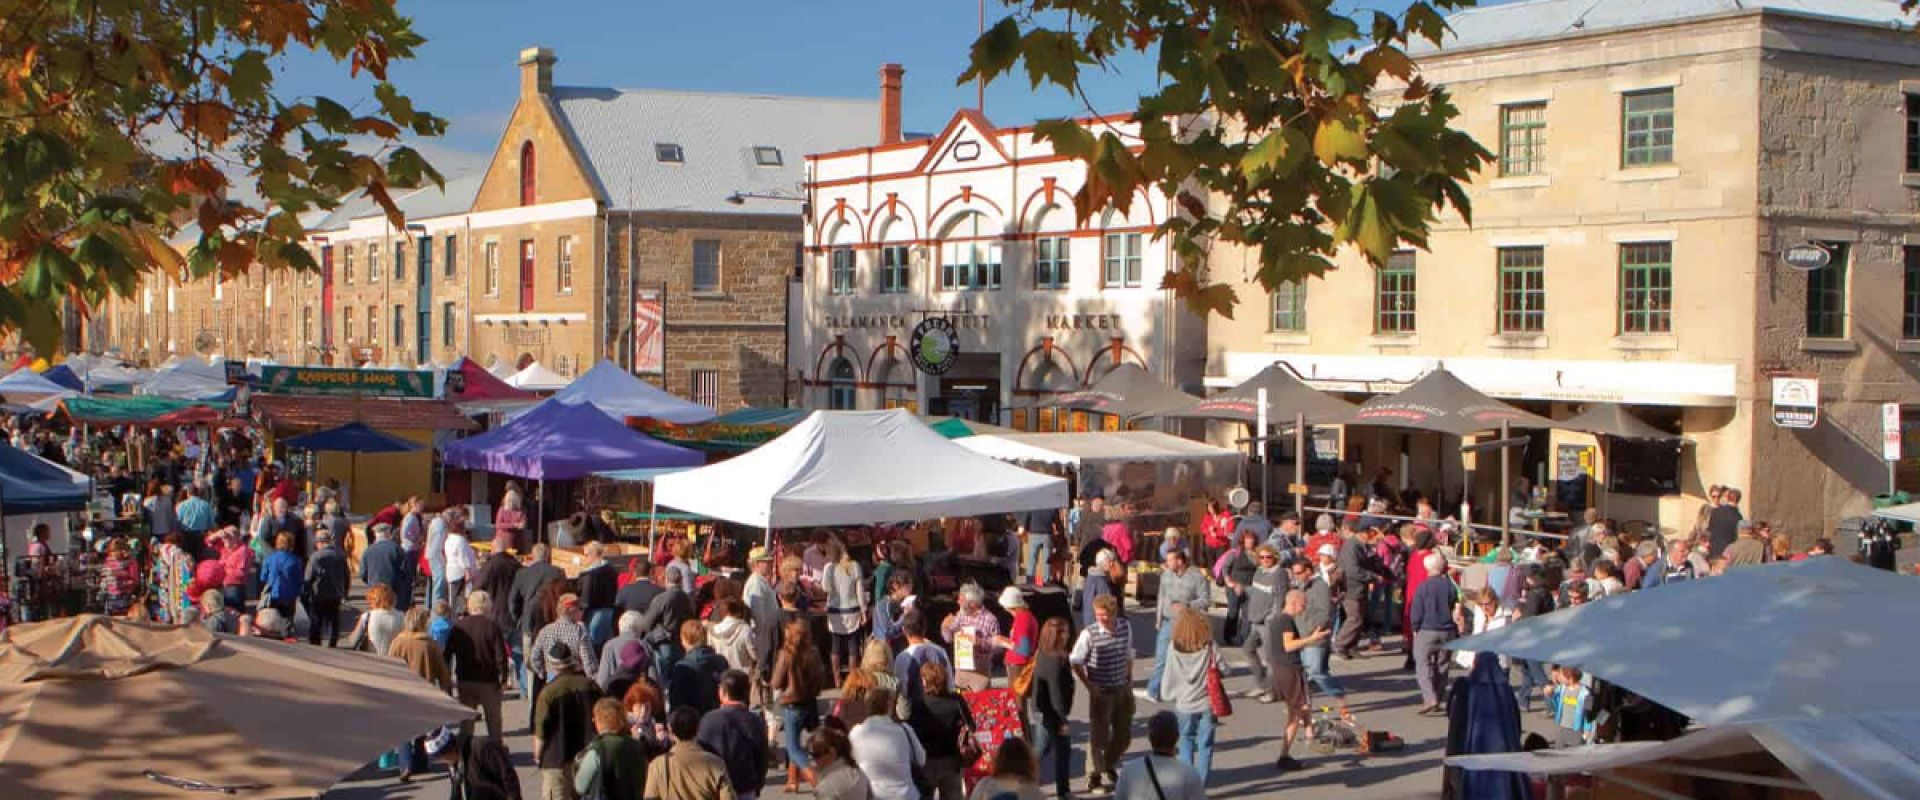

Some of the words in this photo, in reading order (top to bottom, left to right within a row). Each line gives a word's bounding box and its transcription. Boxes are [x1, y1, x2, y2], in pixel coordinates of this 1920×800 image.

[825, 315, 905, 329] SALAMANCA
[944, 314, 990, 329] RUIT
[1046, 314, 1121, 330] MARKET
